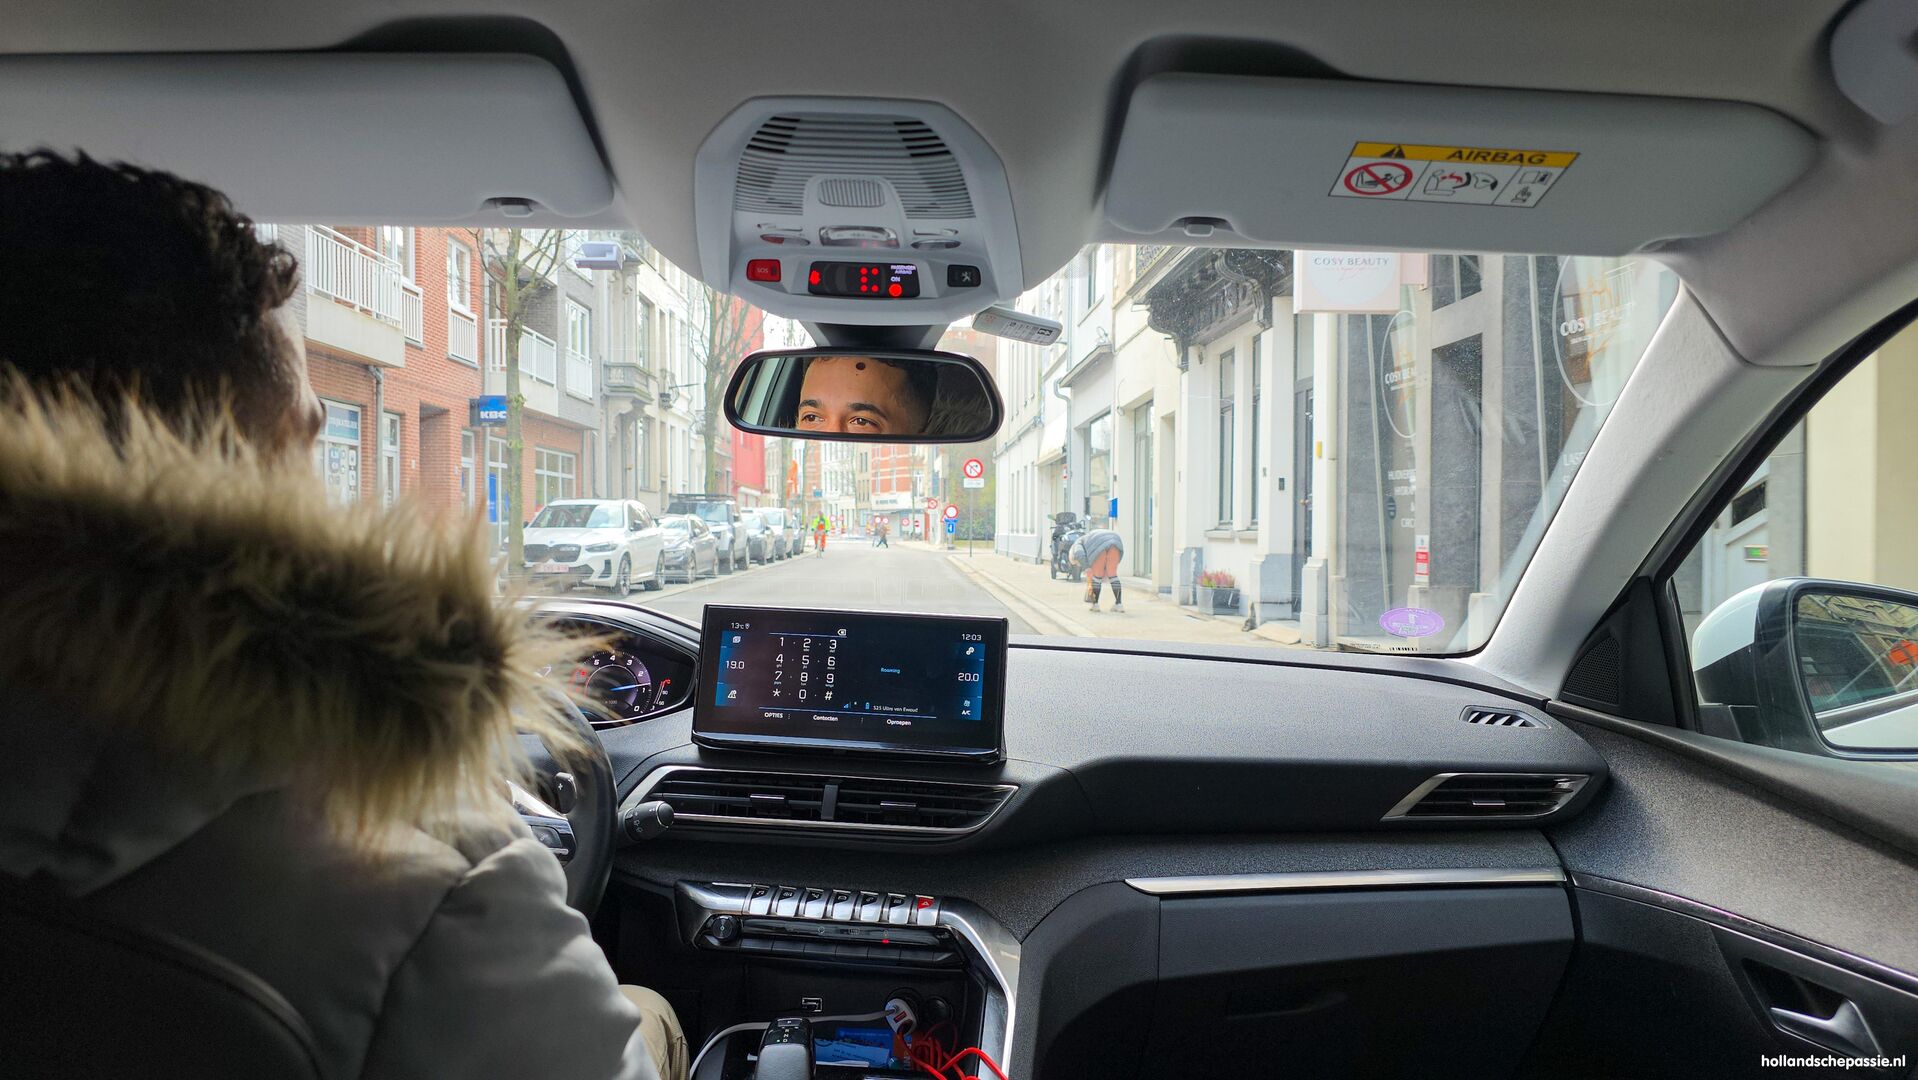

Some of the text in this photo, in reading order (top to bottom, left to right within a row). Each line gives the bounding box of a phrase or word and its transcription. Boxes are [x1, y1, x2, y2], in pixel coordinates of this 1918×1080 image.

[1446, 150, 1548, 165] AIRBAG
[1314, 257, 1390, 266] COSY BEAUTY
[480, 410, 507, 419] KBC
[961, 633, 982, 641] 12:03
[779, 637, 837, 649] 1 2 3
[776, 654, 835, 667] 4 5 6
[775, 671, 834, 684] 7 8 9
[958, 672, 980, 682] 20.0
[798, 689, 807, 699] 0
[886, 719, 911, 727] Oproepen
